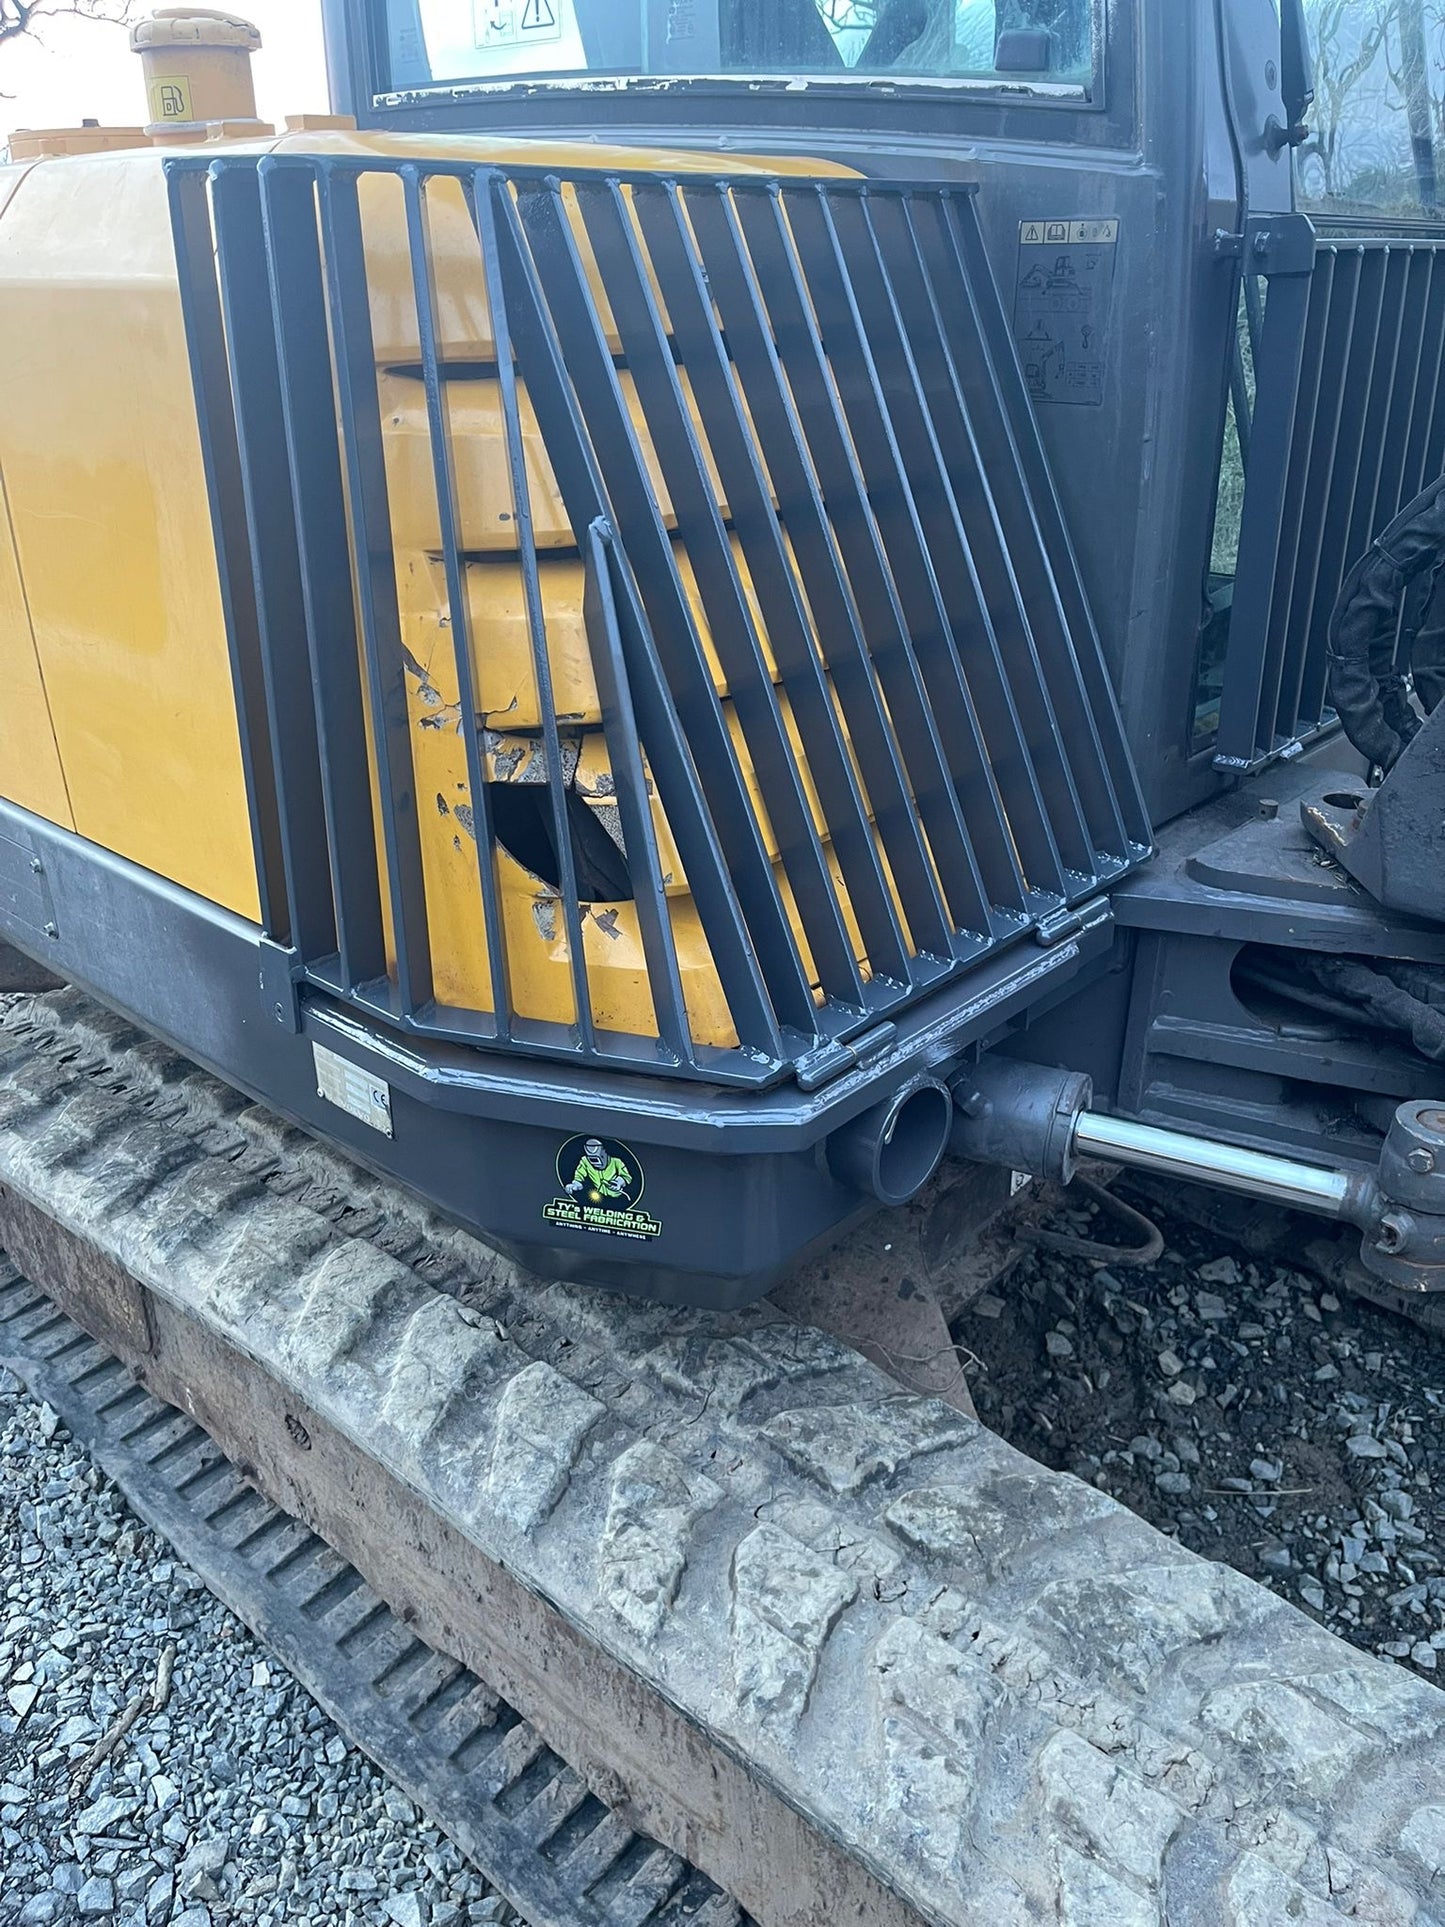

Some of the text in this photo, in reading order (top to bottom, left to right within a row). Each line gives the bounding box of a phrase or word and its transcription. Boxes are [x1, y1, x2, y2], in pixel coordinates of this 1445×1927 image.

[547, 1208, 657, 1232] STEEL FABRICATION
[558, 1202, 645, 1223] TY's WELDING &
[588, 1226, 611, 1234] ANYTIME
[617, 1231, 646, 1239] ANYWHERE
